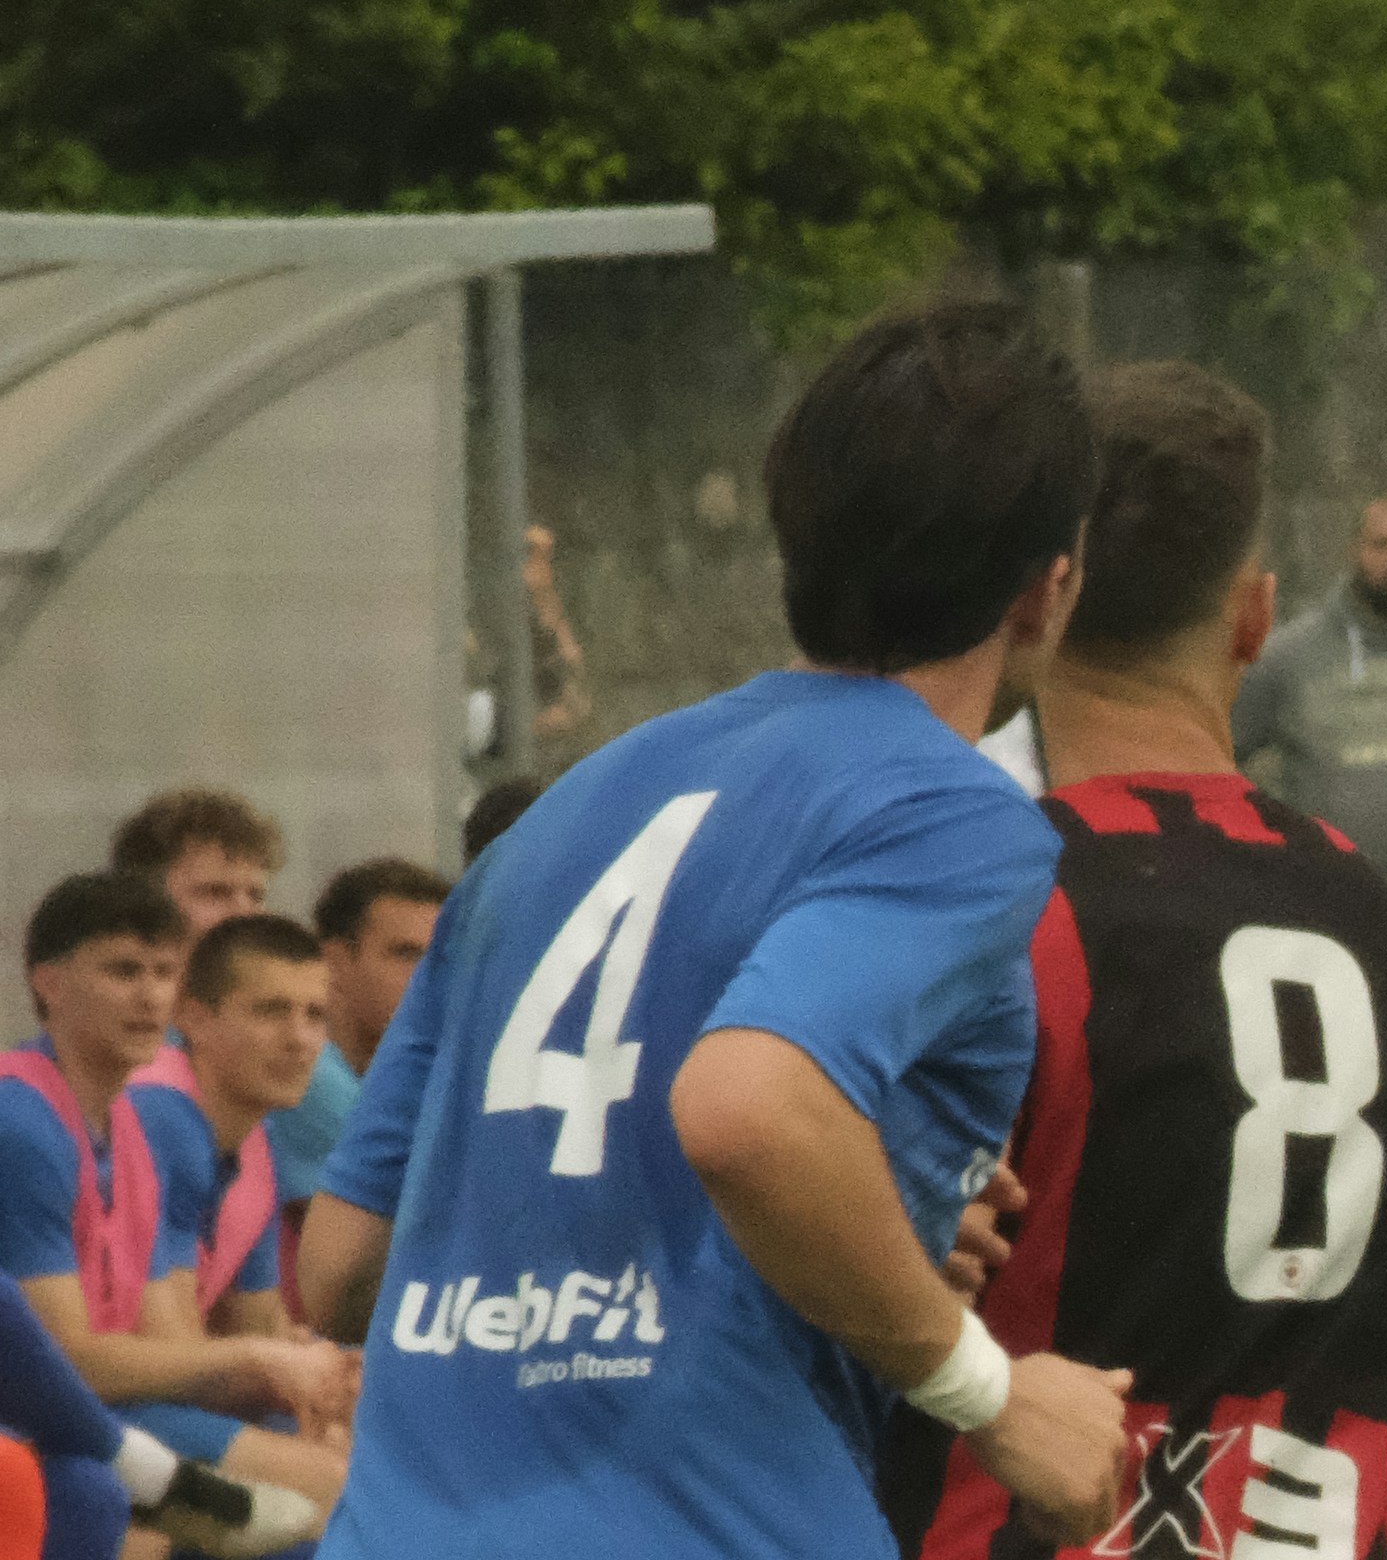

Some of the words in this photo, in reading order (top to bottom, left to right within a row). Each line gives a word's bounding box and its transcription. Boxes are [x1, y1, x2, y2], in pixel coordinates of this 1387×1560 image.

[483, 790, 719, 1177] 4
[1220, 924, 1385, 1302] 8
[391, 1261, 665, 1356] WebFit
